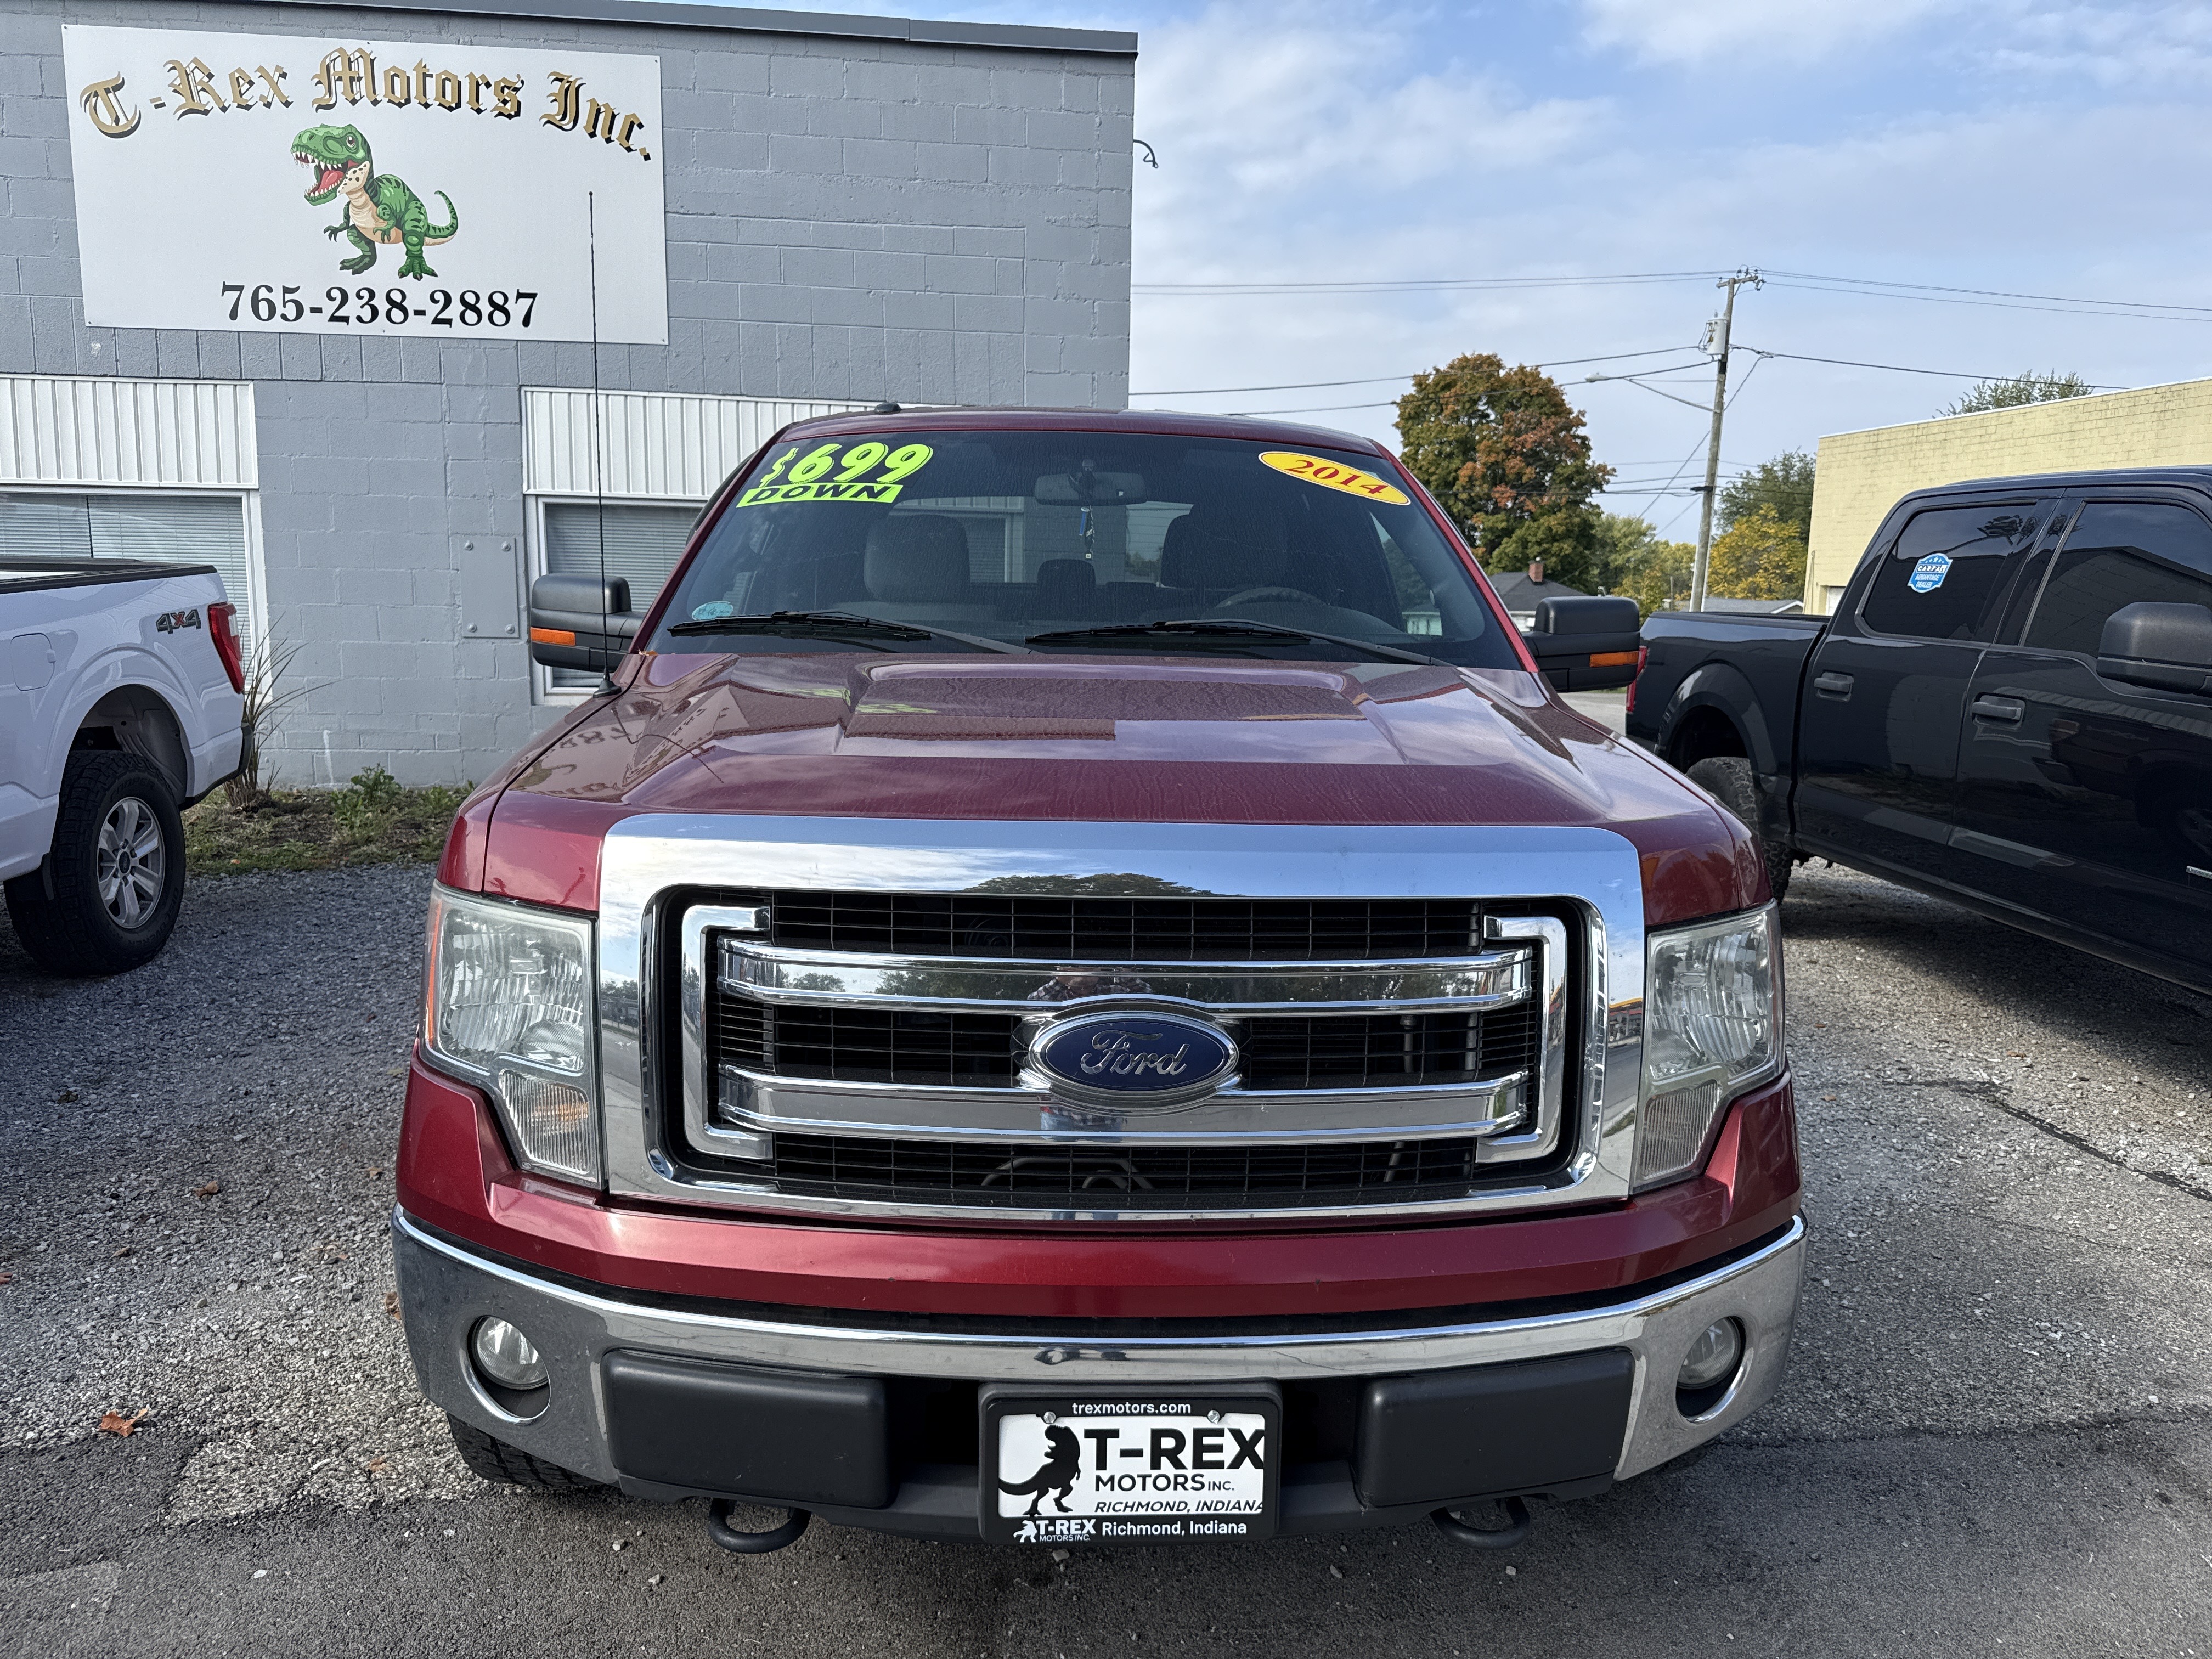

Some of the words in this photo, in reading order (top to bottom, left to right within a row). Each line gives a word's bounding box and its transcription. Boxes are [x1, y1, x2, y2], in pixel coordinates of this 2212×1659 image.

[311, 47, 525, 121] Motors
[538, 71, 652, 162] Inc.
[221, 281, 539, 329] 765-238-2887
[759, 442, 934, 488] $699
[1284, 460, 1389, 494] 2014
[746, 484, 891, 504] DOWN
[1080, 1030, 1190, 1076] Ford
[1072, 1402, 1192, 1415] trexmotors.com
[1084, 1427, 1265, 1471] T-REX
[1095, 1474, 1205, 1492] MOTORS
[1208, 1480, 1234, 1491] INC.
[1094, 1500, 1190, 1514] RICHMOND,
[1036, 1519, 1096, 1535] T-REX
[1102, 1520, 1185, 1536] Richmond,
[1190, 1520, 1247, 1534] Indiana
